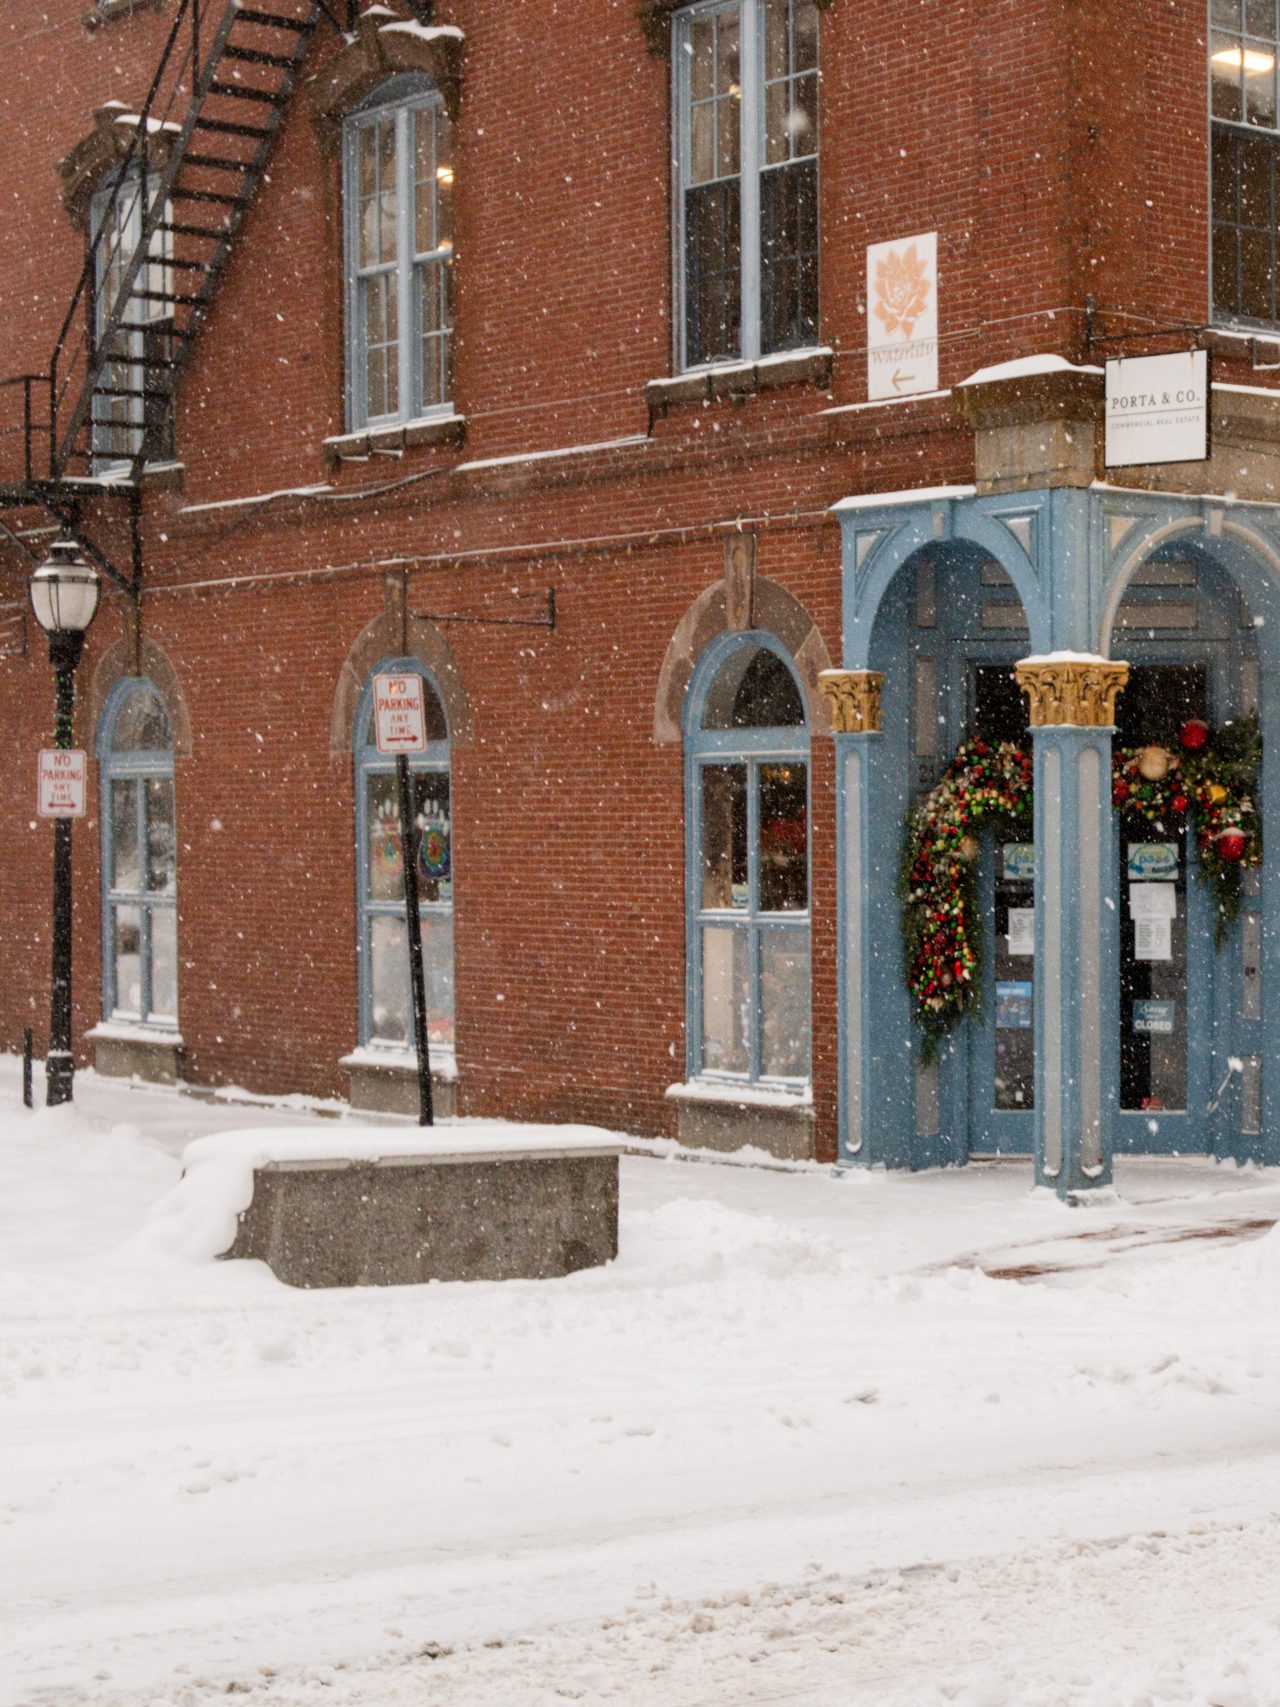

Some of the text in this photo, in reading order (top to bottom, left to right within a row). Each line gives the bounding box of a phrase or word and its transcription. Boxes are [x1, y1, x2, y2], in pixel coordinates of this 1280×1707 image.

[1112, 389, 1200, 409] PORTA & CO.
[1112, 420, 1153, 430] COMMERCIAL
[1175, 415, 1200, 424] ESTATE
[389, 681, 406, 694] NO
[379, 699, 419, 711] PARKING
[391, 714, 408, 723] ANY
[54, 754, 71, 766] NO
[41, 770, 82, 780] PARKING
[53, 783, 70, 791] ANY
[1135, 1020, 1172, 1030] CLOSED
